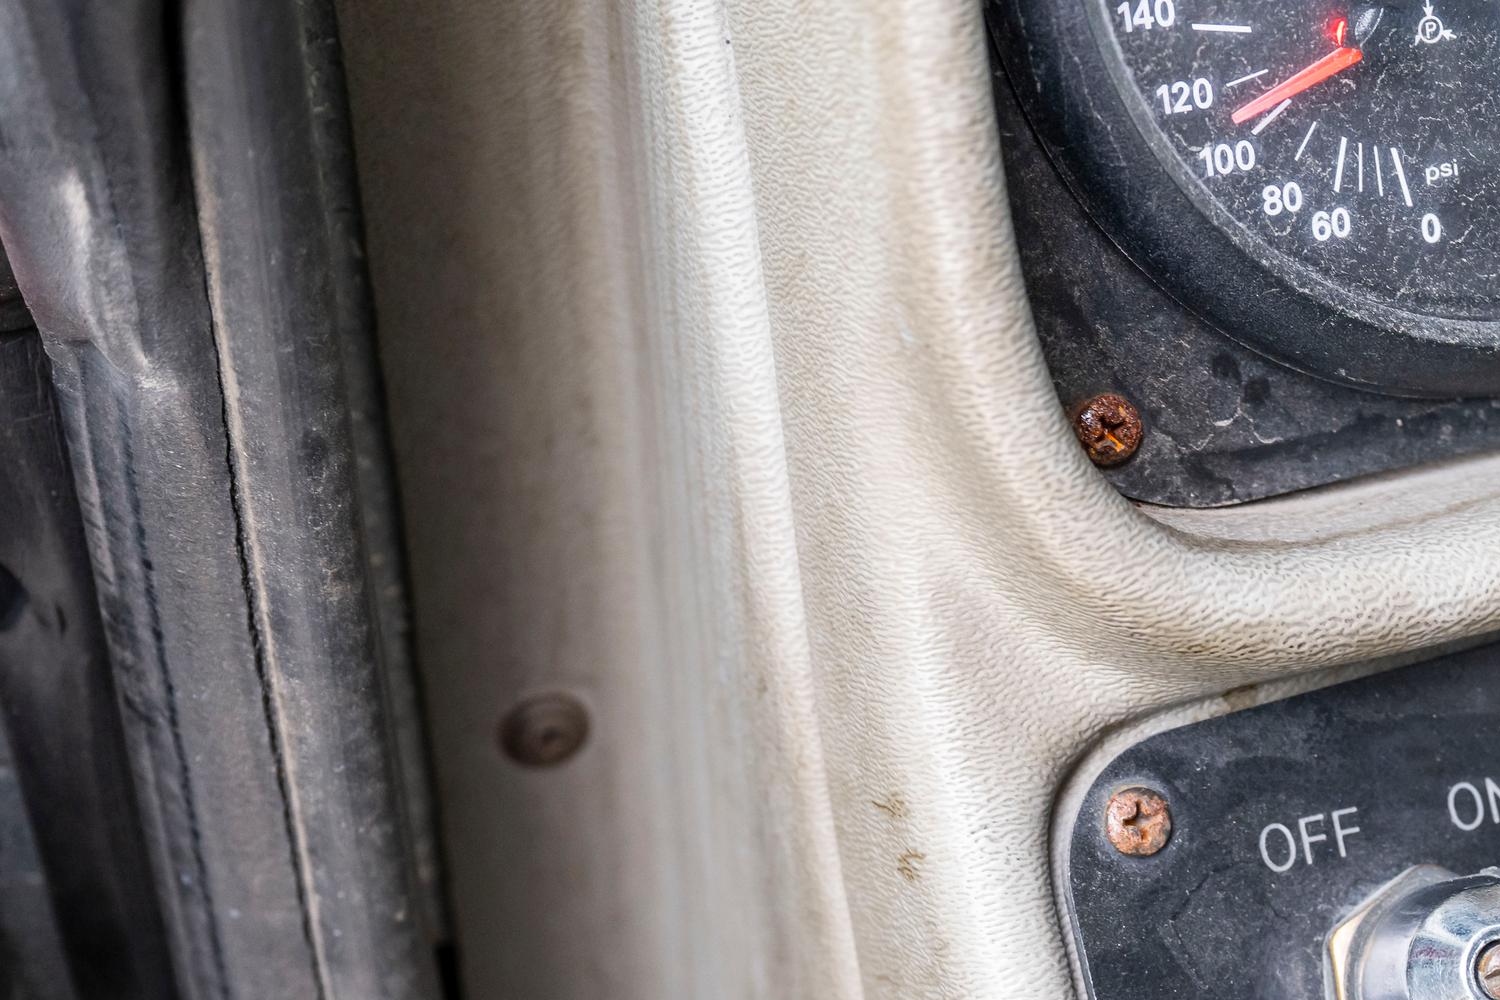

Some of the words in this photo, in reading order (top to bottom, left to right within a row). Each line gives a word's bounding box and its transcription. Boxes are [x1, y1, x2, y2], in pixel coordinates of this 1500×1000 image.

[1117, 0, 1176, 32] 140
[1156, 78, 1213, 115] 120
[1200, 140, 1256, 177] 100
[1425, 158, 1459, 184] psi
[1262, 182, 1302, 216] 80
[1311, 208, 1351, 241] 60
[1421, 213, 1441, 243] 0
[1258, 806, 1361, 873] OFF
